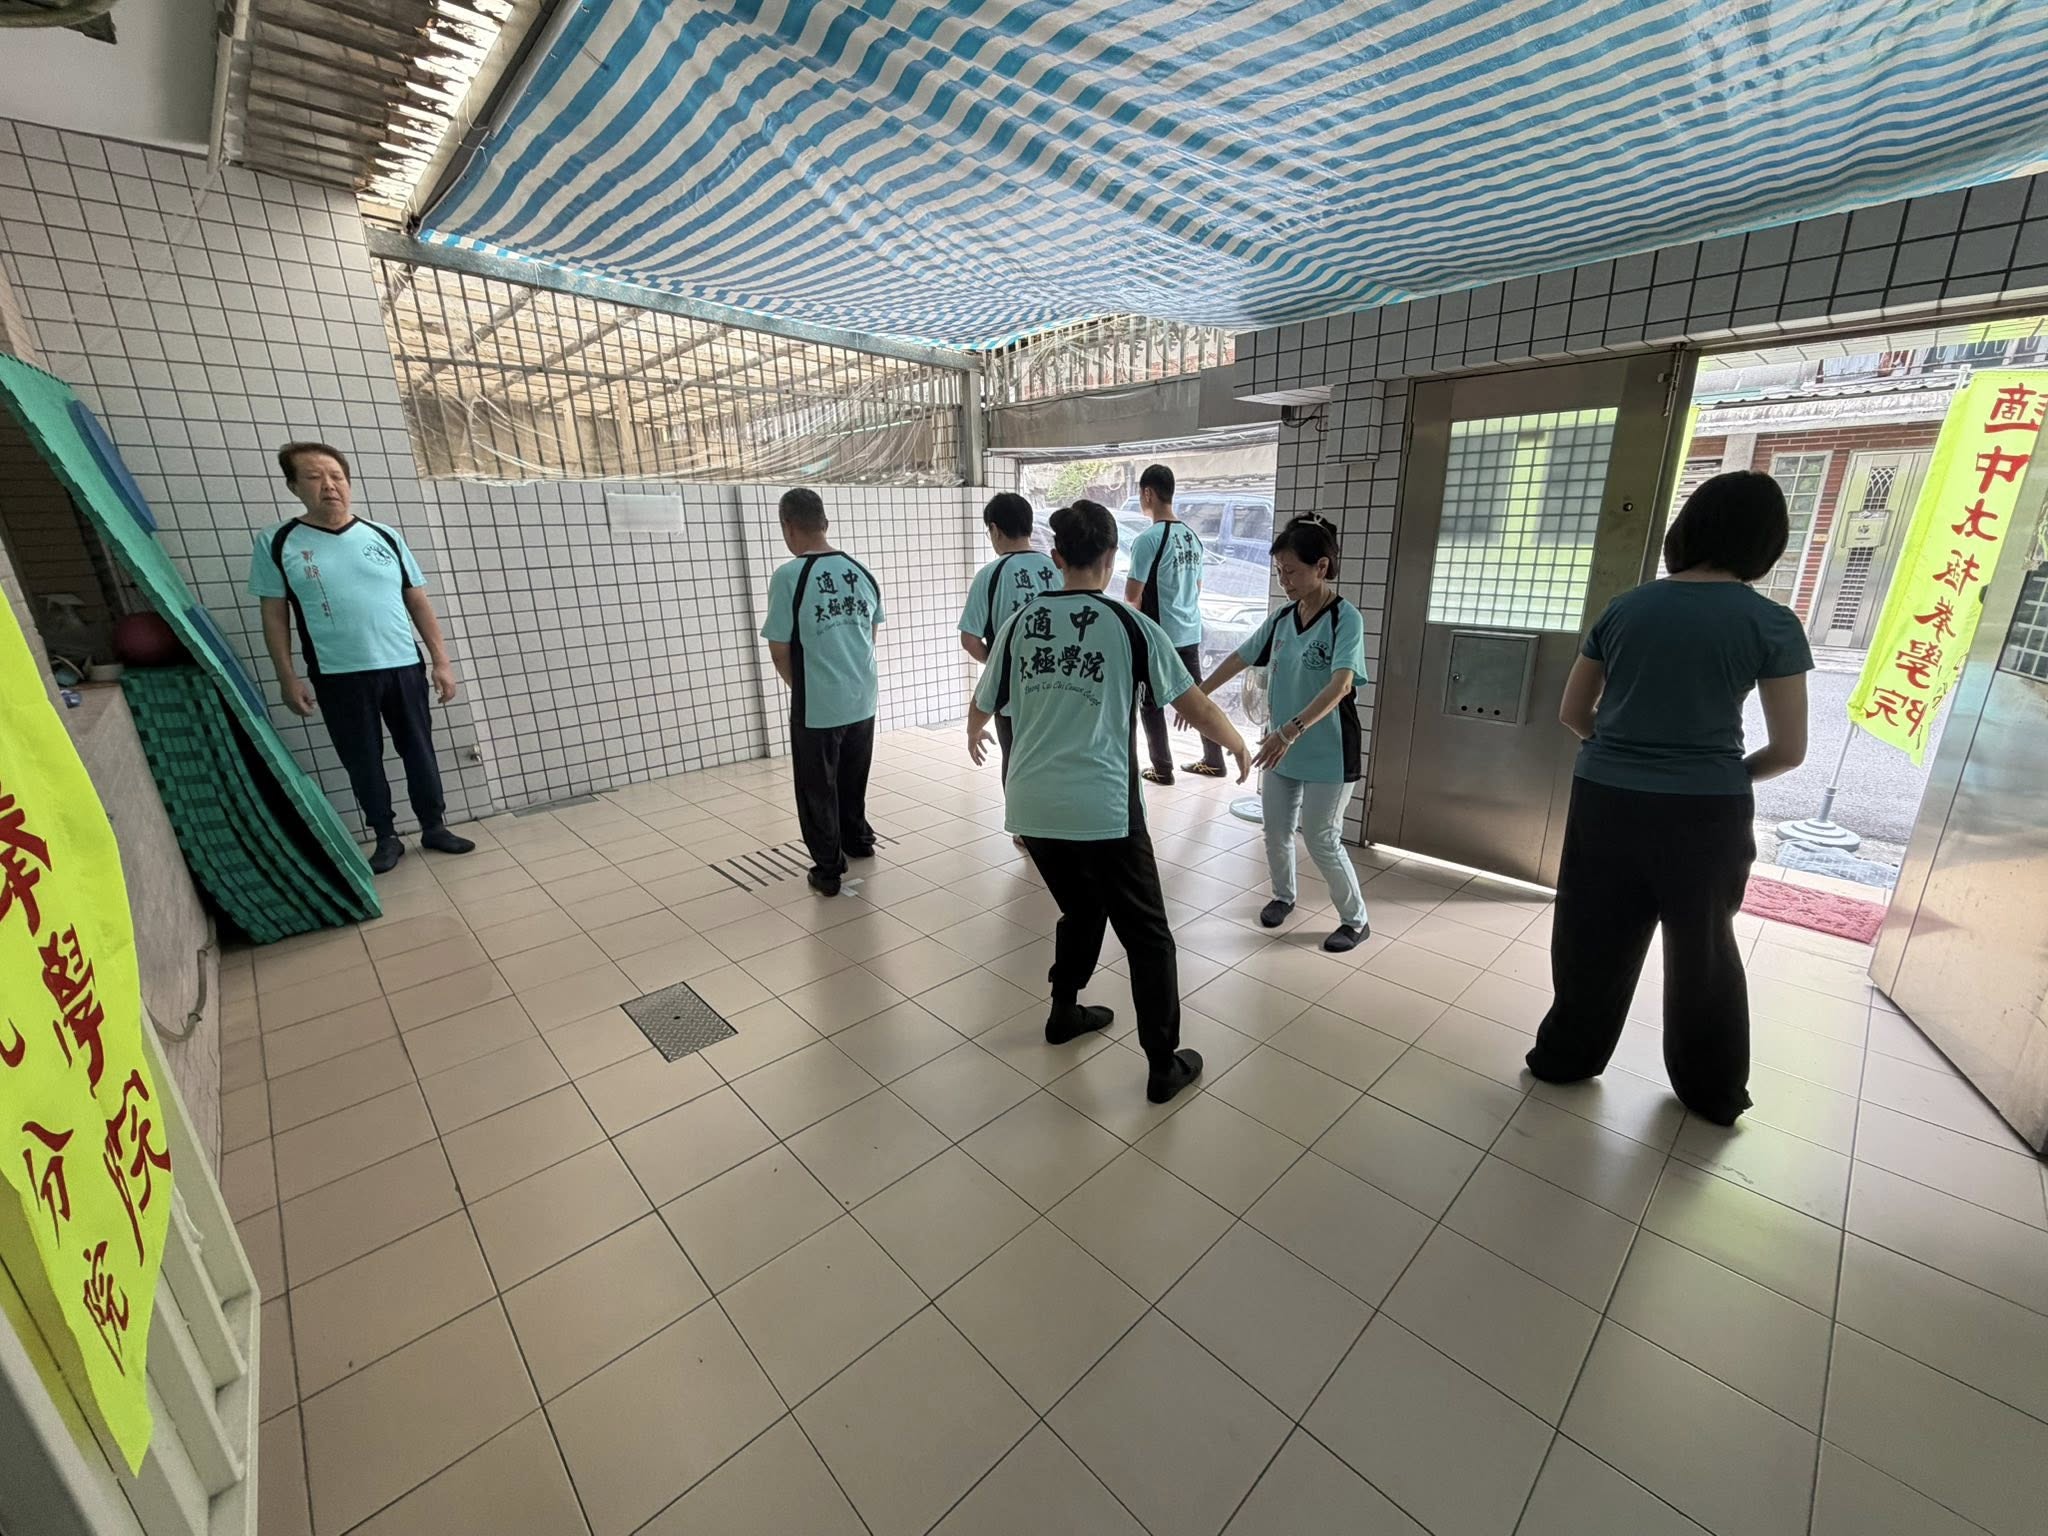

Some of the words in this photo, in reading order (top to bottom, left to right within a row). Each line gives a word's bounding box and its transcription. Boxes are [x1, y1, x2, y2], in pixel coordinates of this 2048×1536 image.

[815, 568, 859, 594] 適中
[1014, 566, 1054, 590] 適中
[814, 595, 870, 624] 太極學院
[1023, 605, 1100, 643] 適中
[1019, 644, 1105, 683] 太極學院
